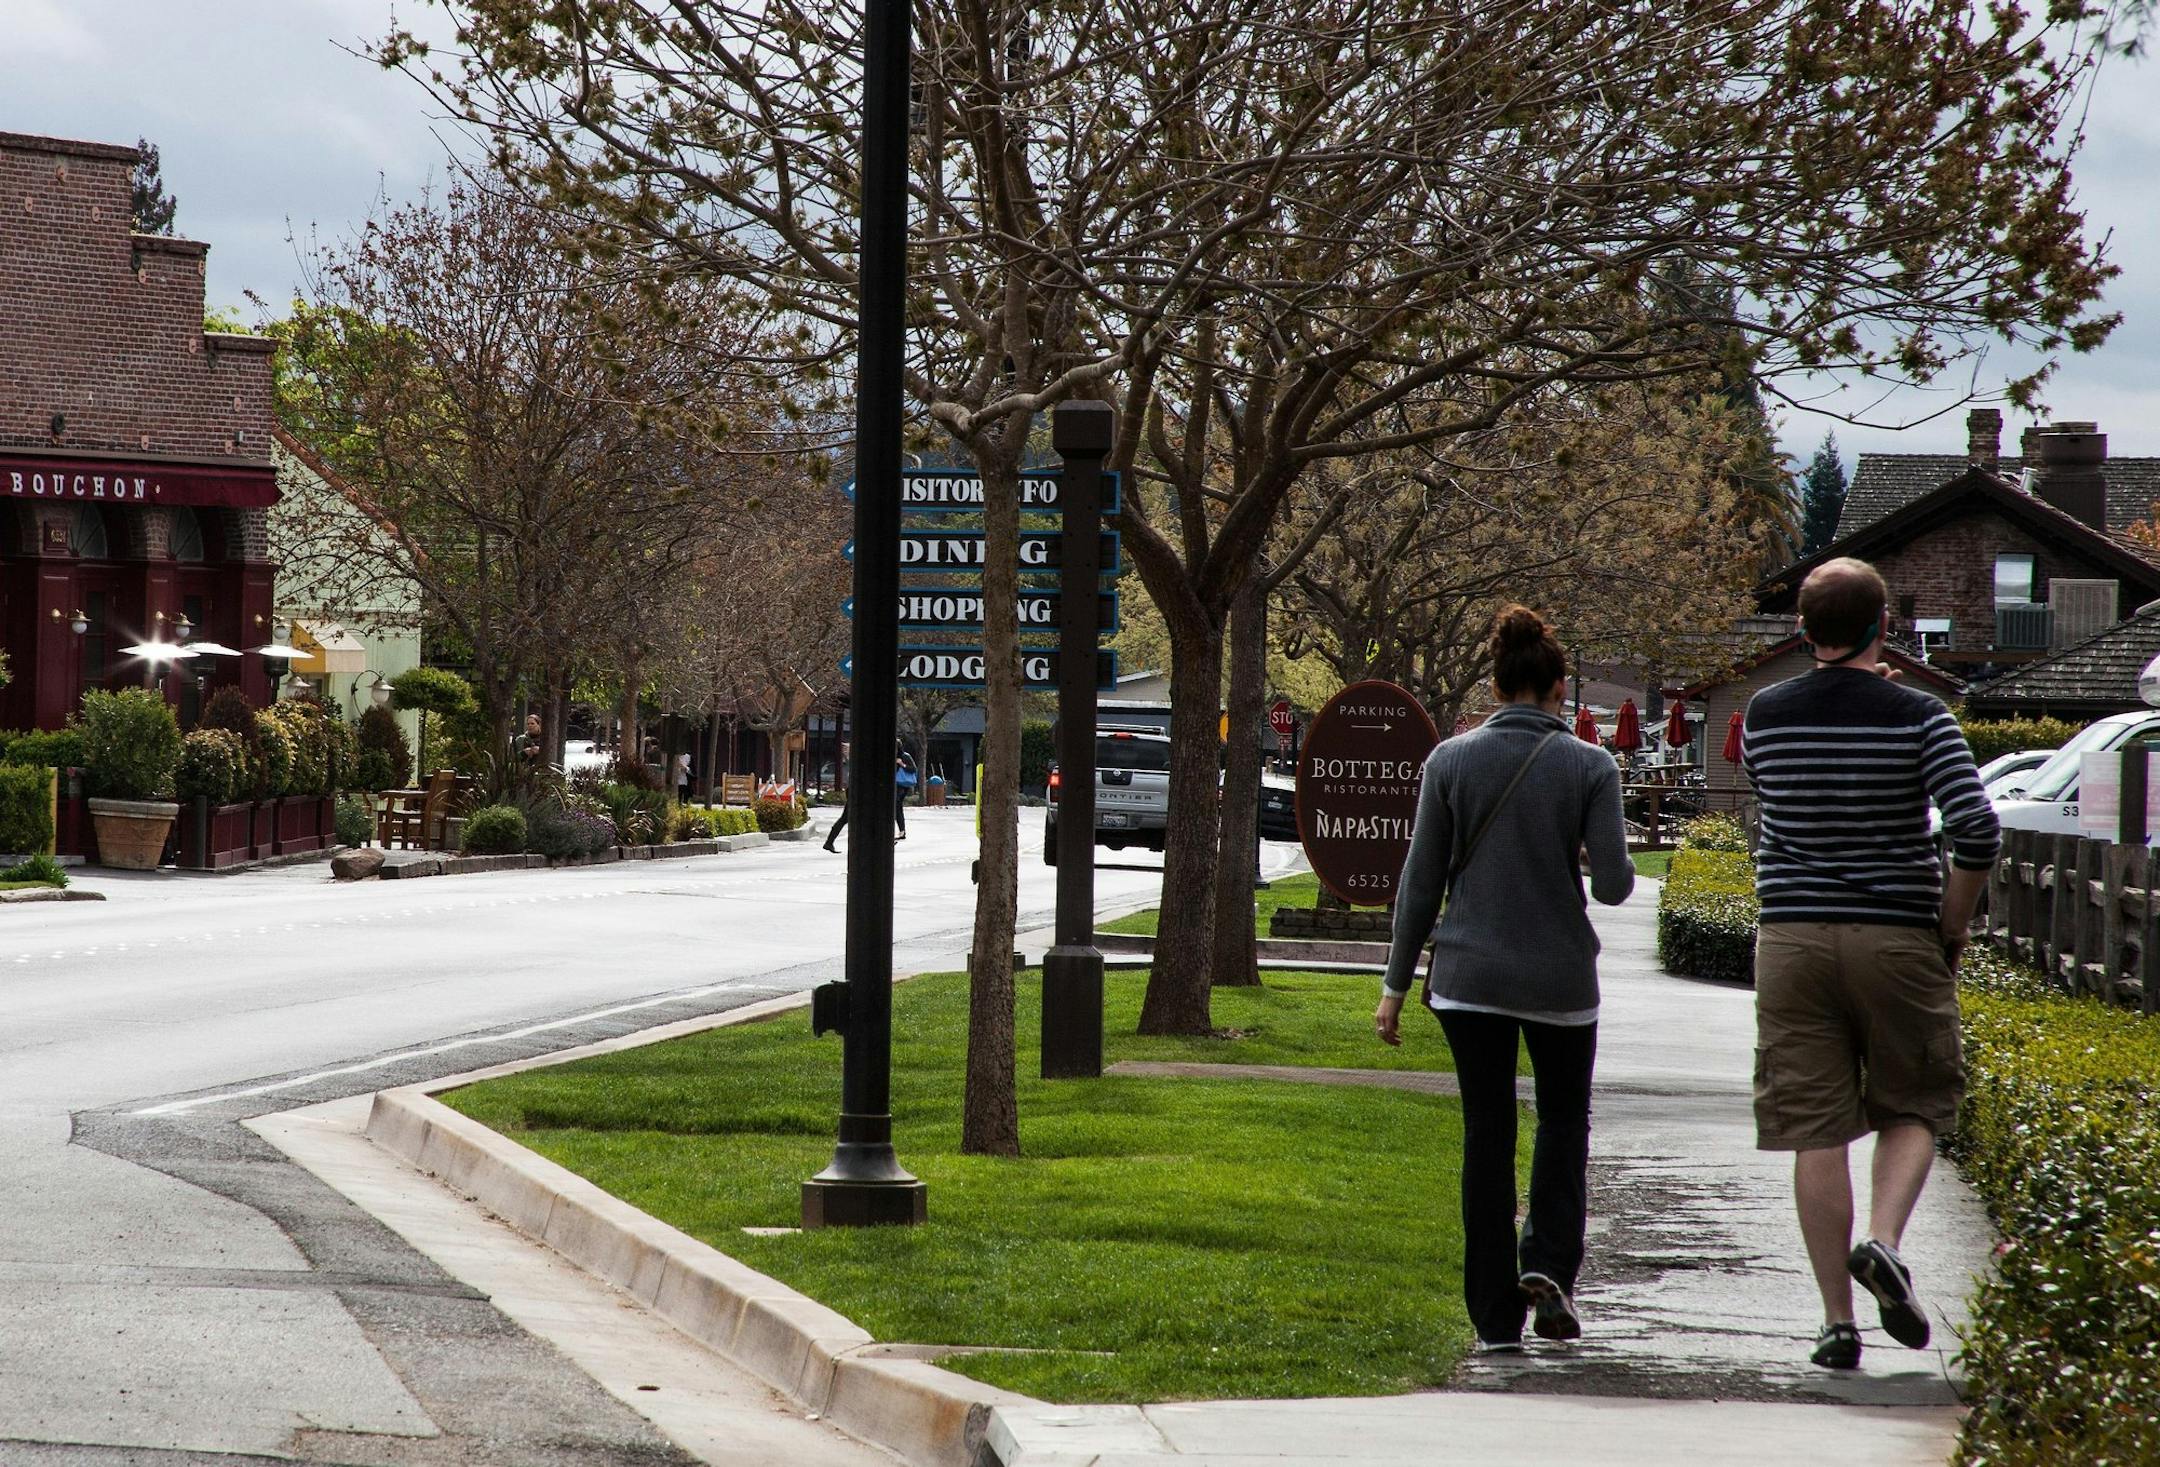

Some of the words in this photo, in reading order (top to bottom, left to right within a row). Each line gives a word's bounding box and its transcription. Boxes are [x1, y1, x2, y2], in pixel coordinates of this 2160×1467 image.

[10, 472, 145, 498] BOUCHON
[902, 478, 984, 502] ISITOR
[900, 539, 1048, 564] DINIG
[898, 597, 1051, 623] HOPNG
[898, 655, 1050, 681] ODGG
[1271, 711, 1294, 725] STO
[1340, 705, 1407, 717] PARKING
[1312, 757, 1426, 780] BOTTEGA
[1324, 784, 1418, 796] RISTORANTE
[1348, 875, 1390, 888] 6525
